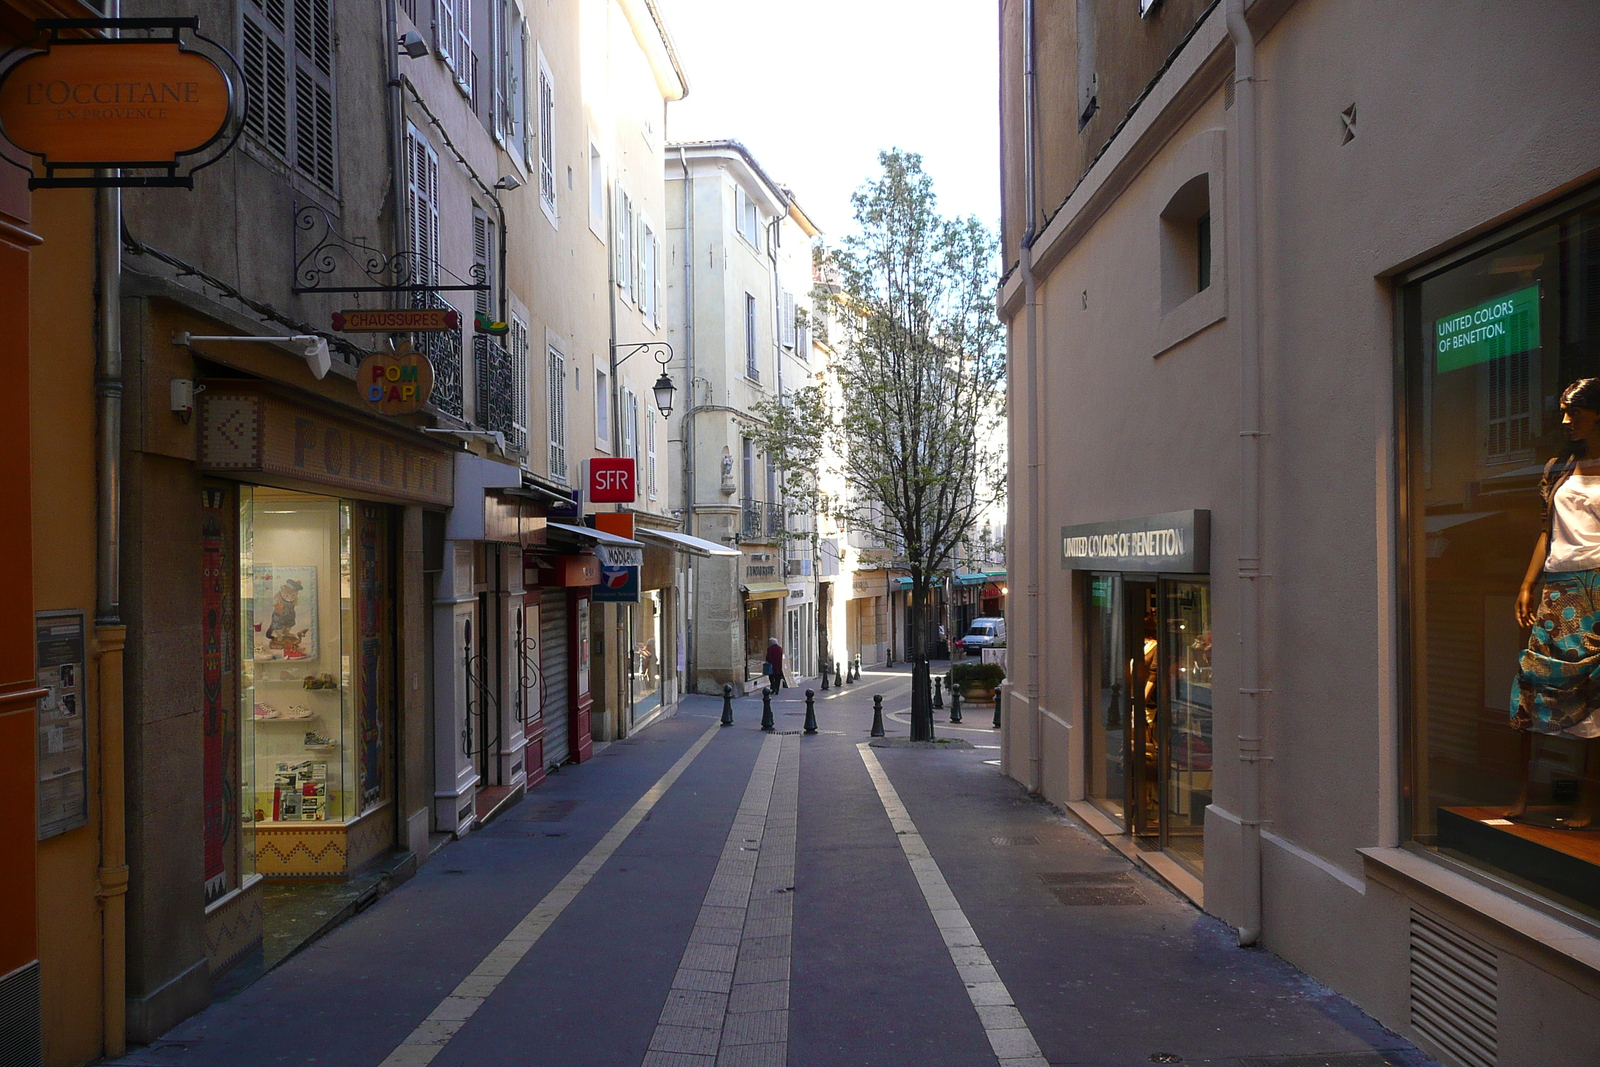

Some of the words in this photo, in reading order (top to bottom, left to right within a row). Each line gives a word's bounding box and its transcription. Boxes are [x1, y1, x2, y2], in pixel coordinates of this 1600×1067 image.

[25, 79, 199, 105] L'OCCITANE
[57, 108, 76, 120] EN
[82, 108, 167, 120] PROVENCE
[350, 313, 439, 327] CHAUSSURES
[1438, 314, 1472, 336] UNITED
[1474, 300, 1514, 325] COLORS
[1438, 338, 1451, 353] OF
[1453, 322, 1505, 349] BENETTON.
[372, 364, 418, 383] POM
[368, 384, 421, 403] D'API
[595, 470, 629, 490] SFR
[1063, 537, 1087, 557] UNITED
[1088, 533, 1118, 557] COLORS
[1118, 533, 1131, 557] OF
